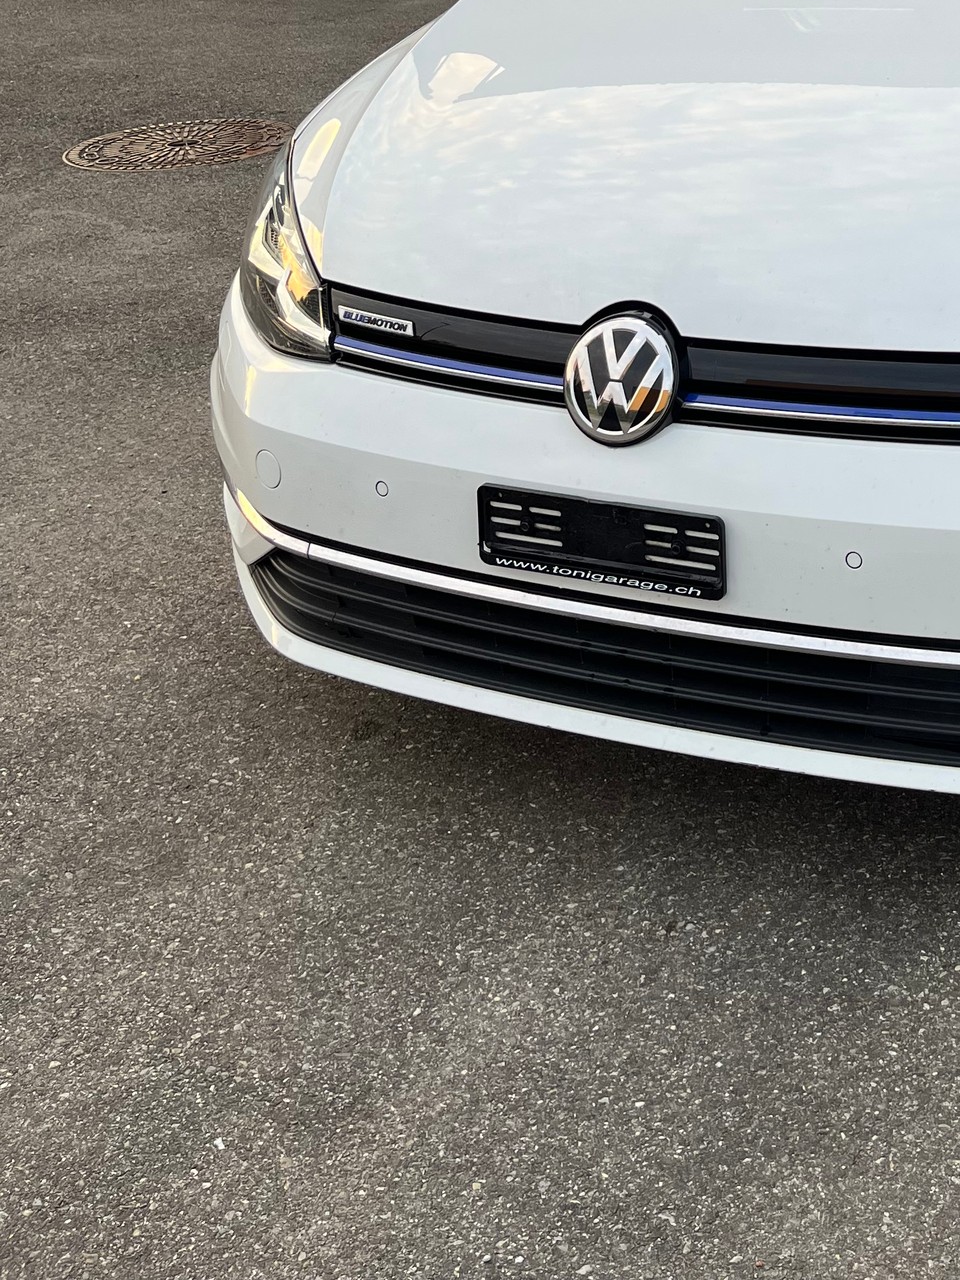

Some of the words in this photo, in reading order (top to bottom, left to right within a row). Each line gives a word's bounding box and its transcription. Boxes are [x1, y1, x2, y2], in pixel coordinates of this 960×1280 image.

[343, 310, 408, 332] BLUEMOTION
[568, 319, 670, 438] VW
[495, 557, 702, 597] www.tonigarage.ch
